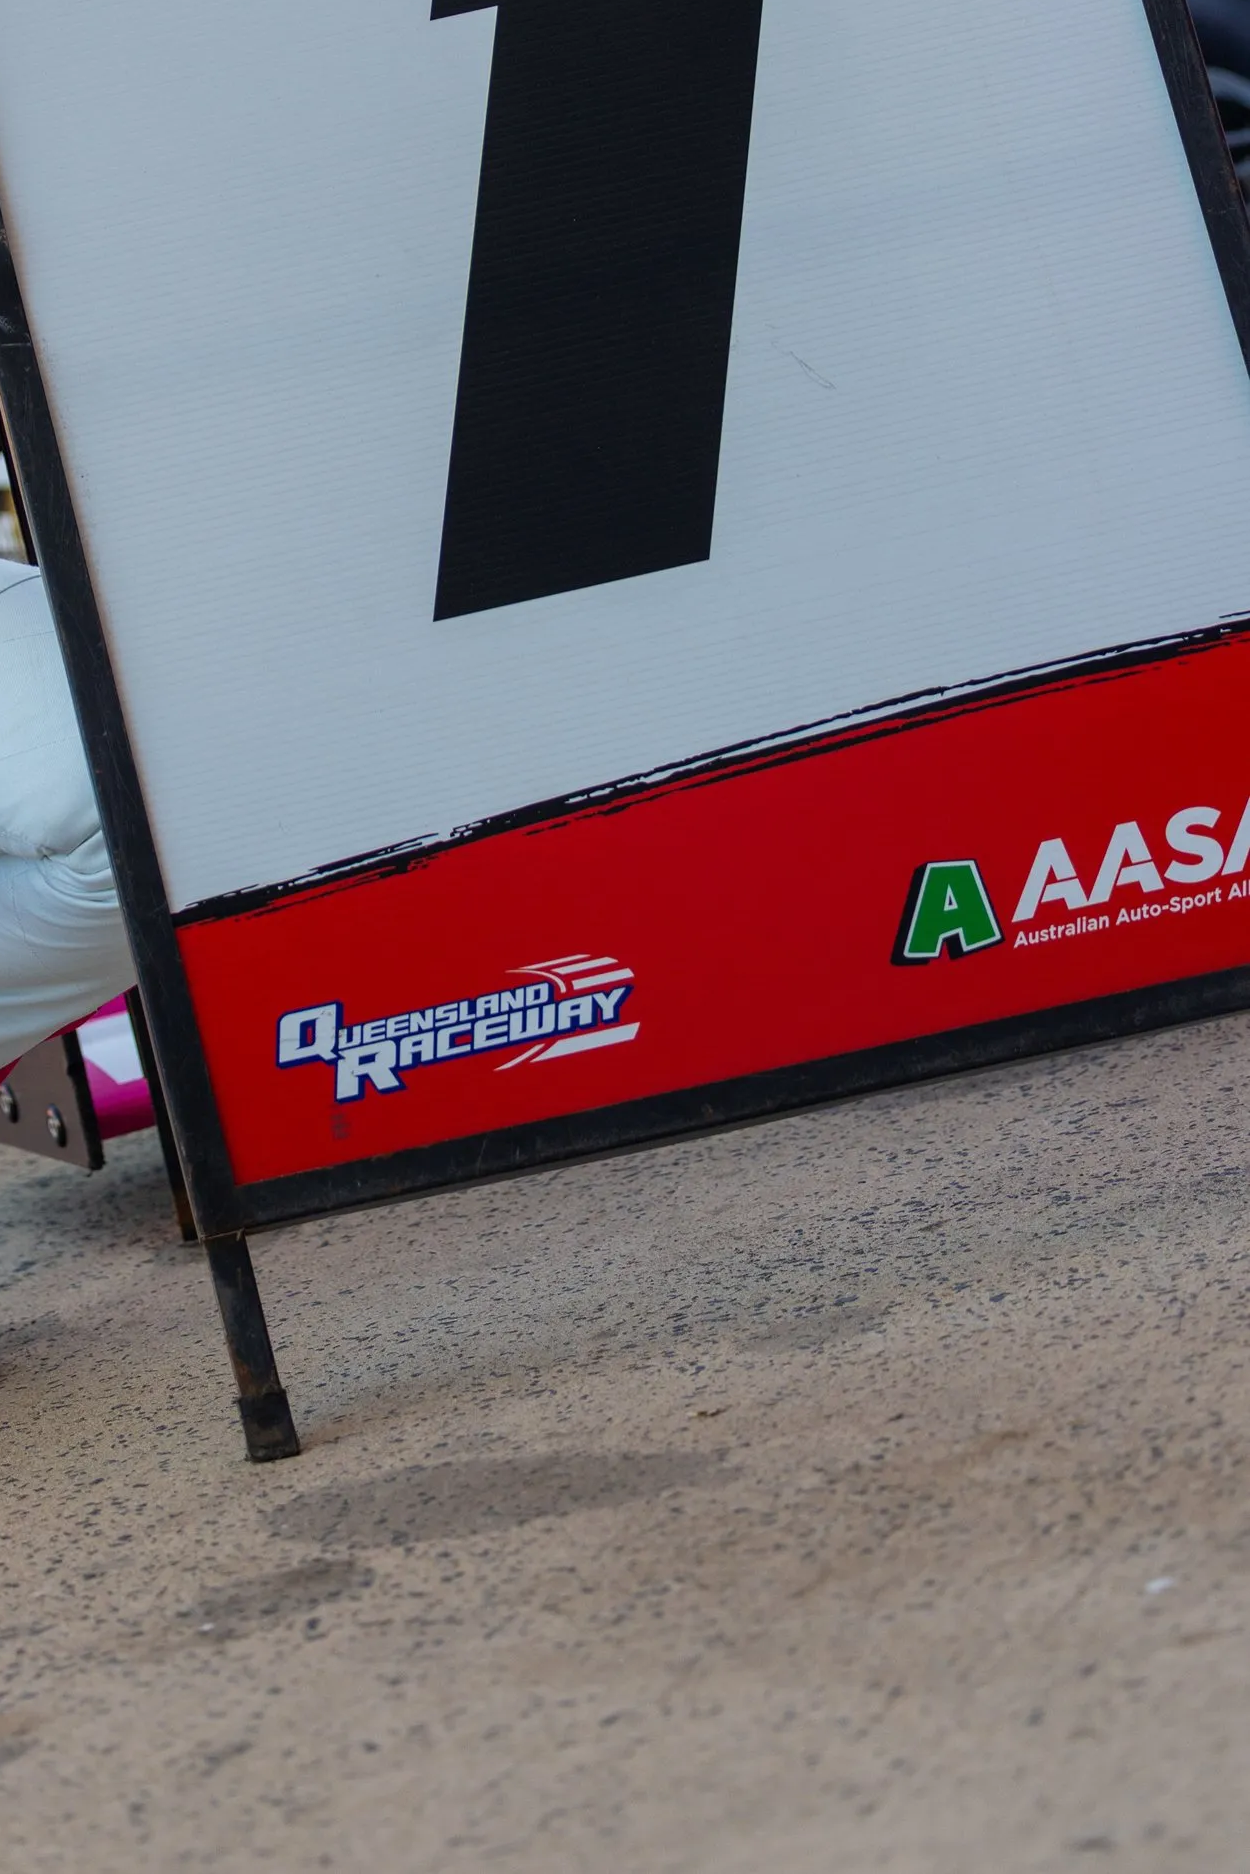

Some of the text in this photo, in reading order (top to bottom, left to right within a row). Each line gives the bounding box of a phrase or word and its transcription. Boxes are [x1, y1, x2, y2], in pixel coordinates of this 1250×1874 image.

[1013, 915, 1110, 949] Australian
[1116, 887, 1222, 925] Auto-Sport
[278, 982, 552, 1067] QUEENSLAND
[334, 986, 633, 1102] RACEWAY
